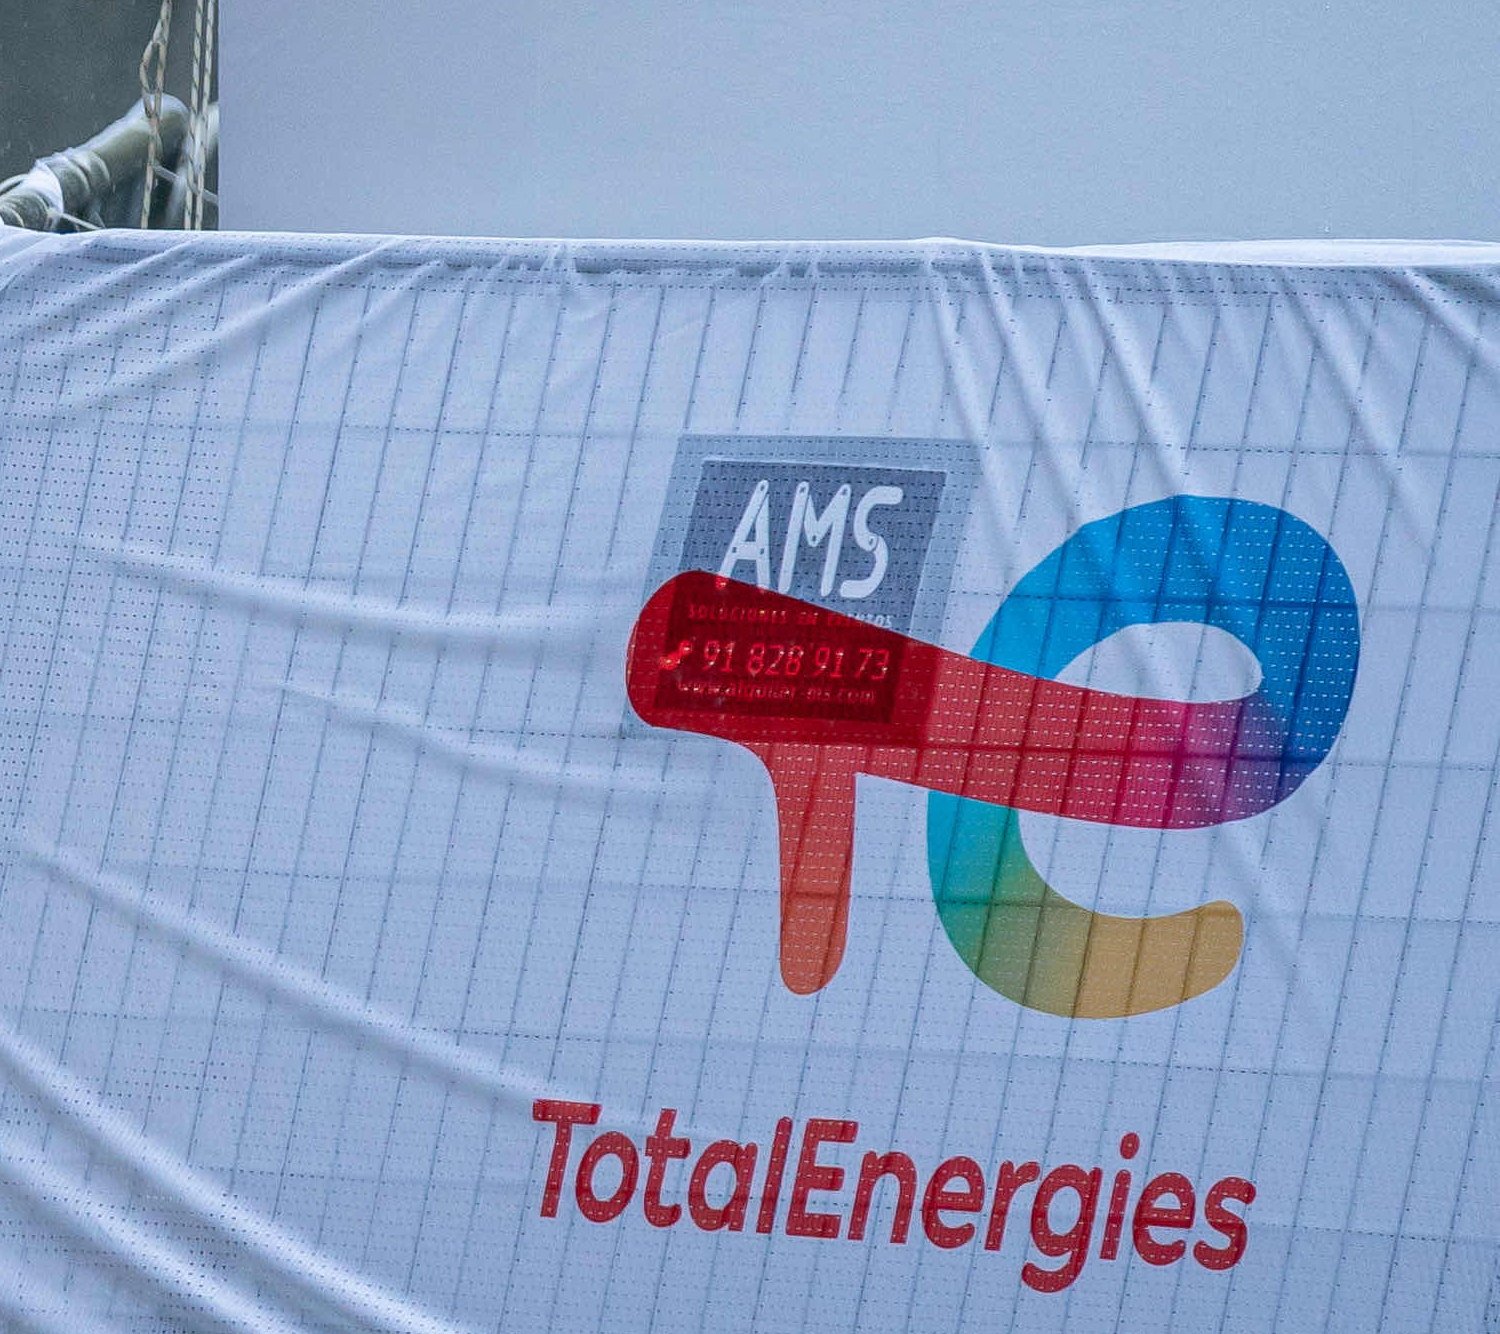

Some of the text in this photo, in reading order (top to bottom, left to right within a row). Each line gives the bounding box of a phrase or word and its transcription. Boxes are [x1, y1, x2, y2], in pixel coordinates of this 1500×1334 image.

[715, 479, 904, 599] AMS
[702, 640, 890, 681] 91 828 91 73
[532, 1098, 1257, 1294] TotalEnergies
